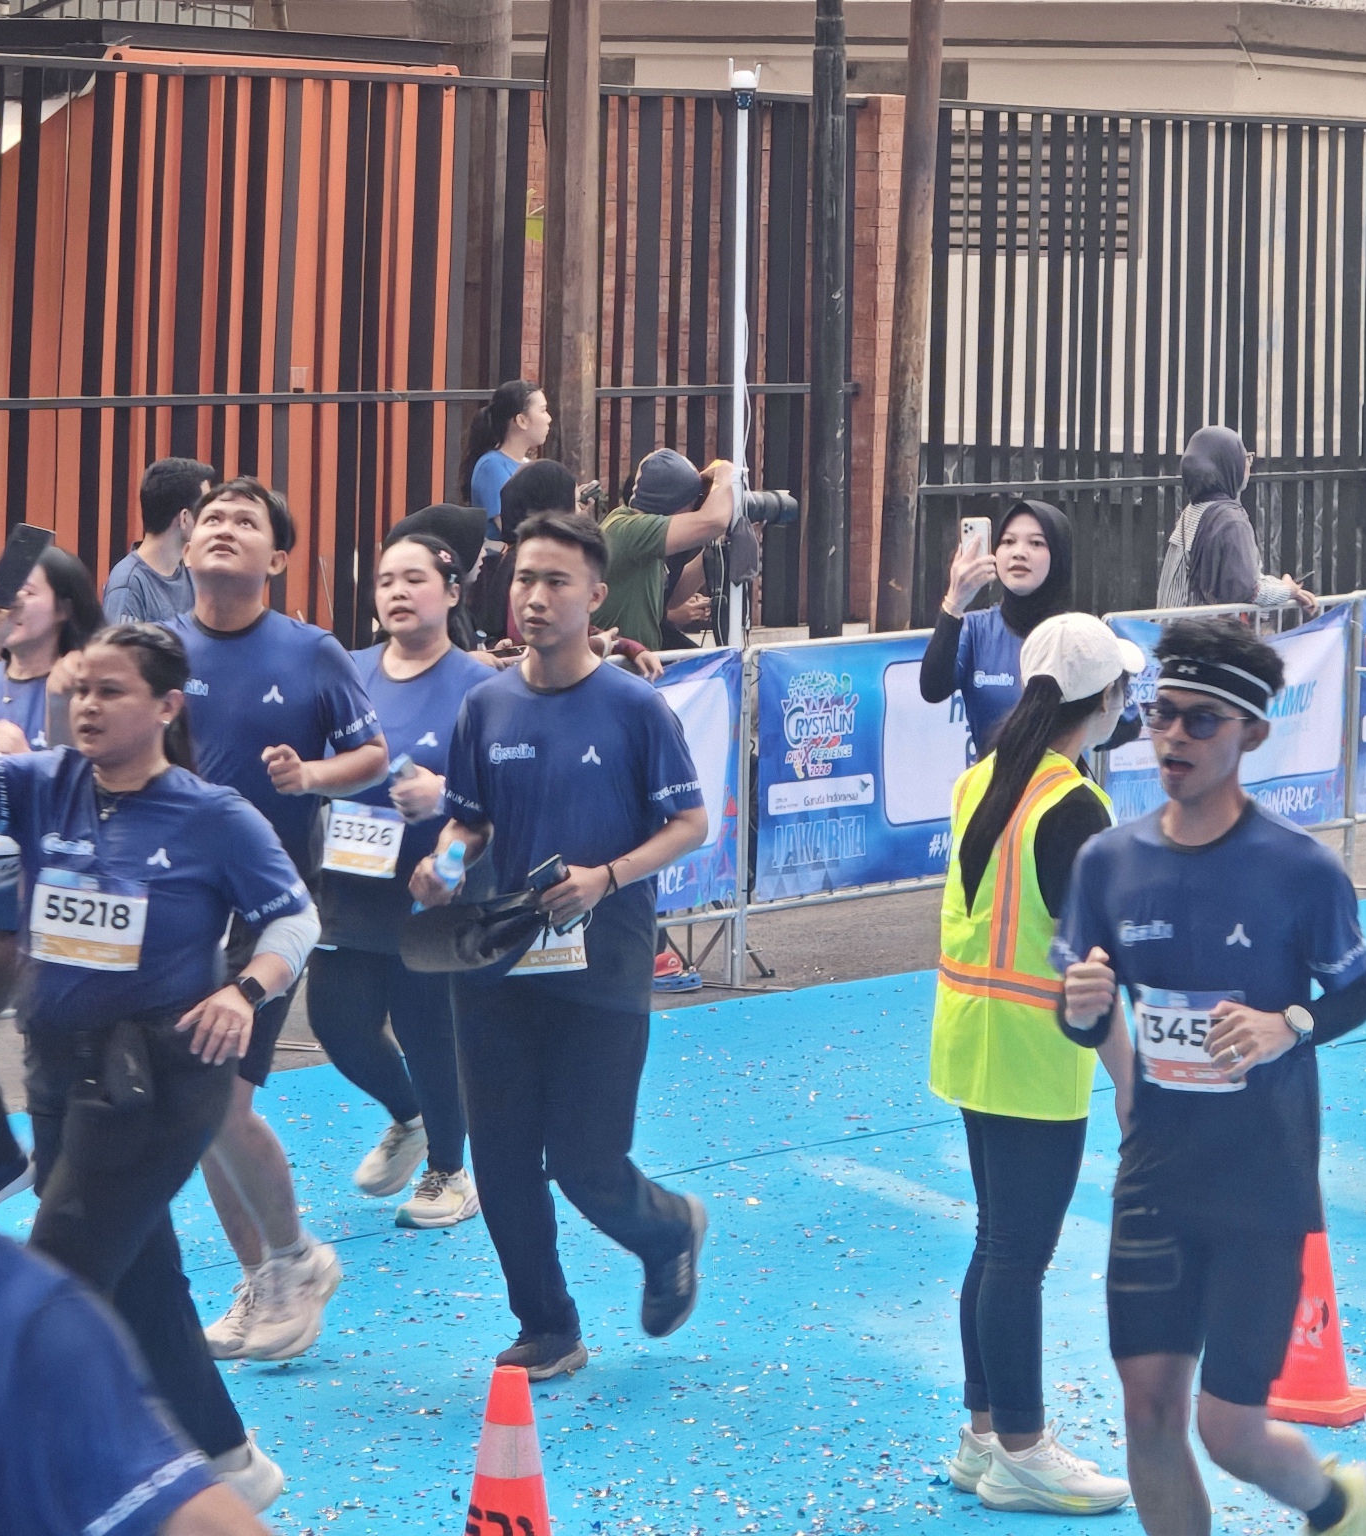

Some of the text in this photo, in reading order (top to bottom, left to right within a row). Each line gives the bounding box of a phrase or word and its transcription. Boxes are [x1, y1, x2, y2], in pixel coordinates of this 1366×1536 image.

[826, 792, 858, 803] Indonesia
[773, 814, 867, 869] JAKARTA
[44, 894, 130, 930] 55218
[571, 946, 586, 962] M
[1141, 1012, 1219, 1047] 1345
